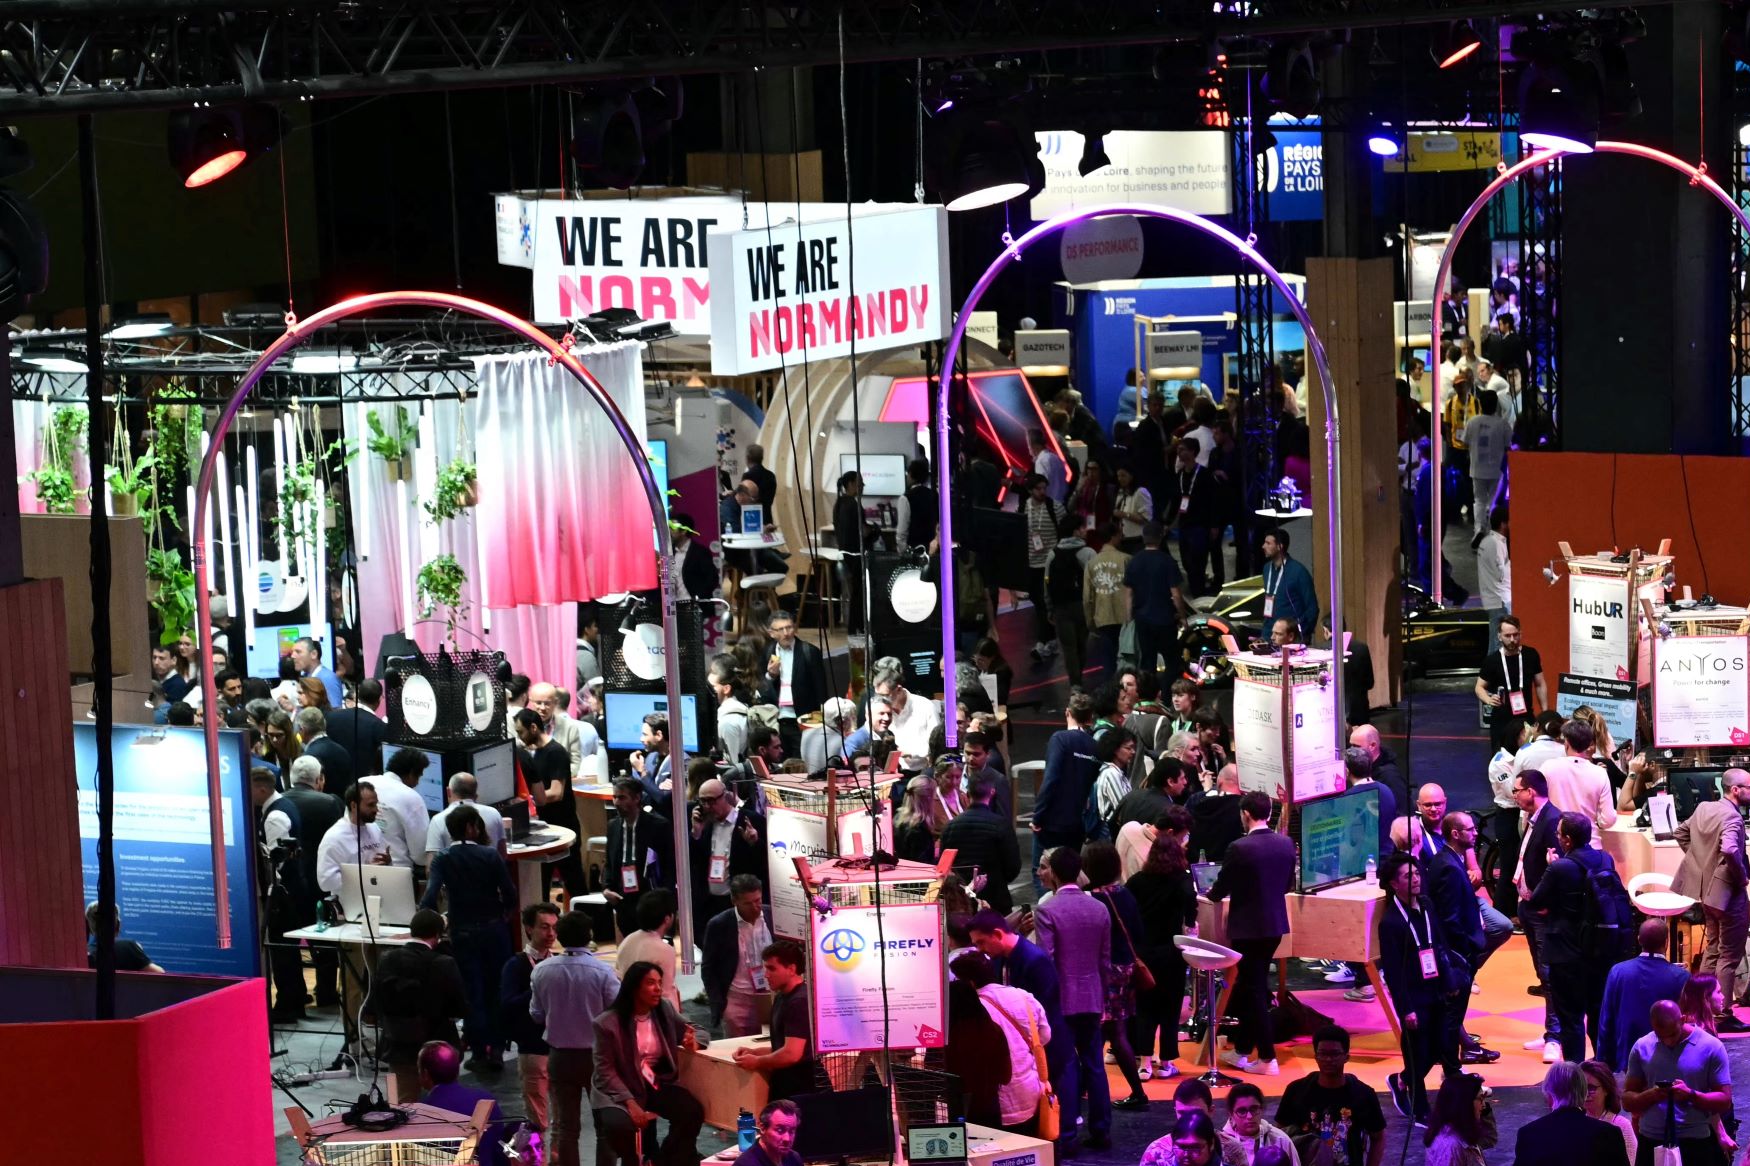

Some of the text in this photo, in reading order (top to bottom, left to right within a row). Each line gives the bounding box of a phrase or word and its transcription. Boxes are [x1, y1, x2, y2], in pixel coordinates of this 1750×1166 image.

[1135, 165, 1175, 179] shaping
[1177, 164, 1194, 176] the
[1284, 161, 1321, 176] PAYS
[1123, 181, 1168, 192] business
[1171, 180, 1189, 191] and
[555, 216, 622, 267] WE
[1080, 237, 1140, 257] PERFORMANCE
[747, 236, 840, 302] WE ARE
[749, 284, 929, 358] NORMANDY
[1023, 342, 1065, 353] GAZOTECH
[1573, 598, 1623, 619] HubUR
[1659, 653, 1744, 676] ANYOS
[1705, 679, 1731, 687] change
[873, 938, 934, 950] FIREFLY
